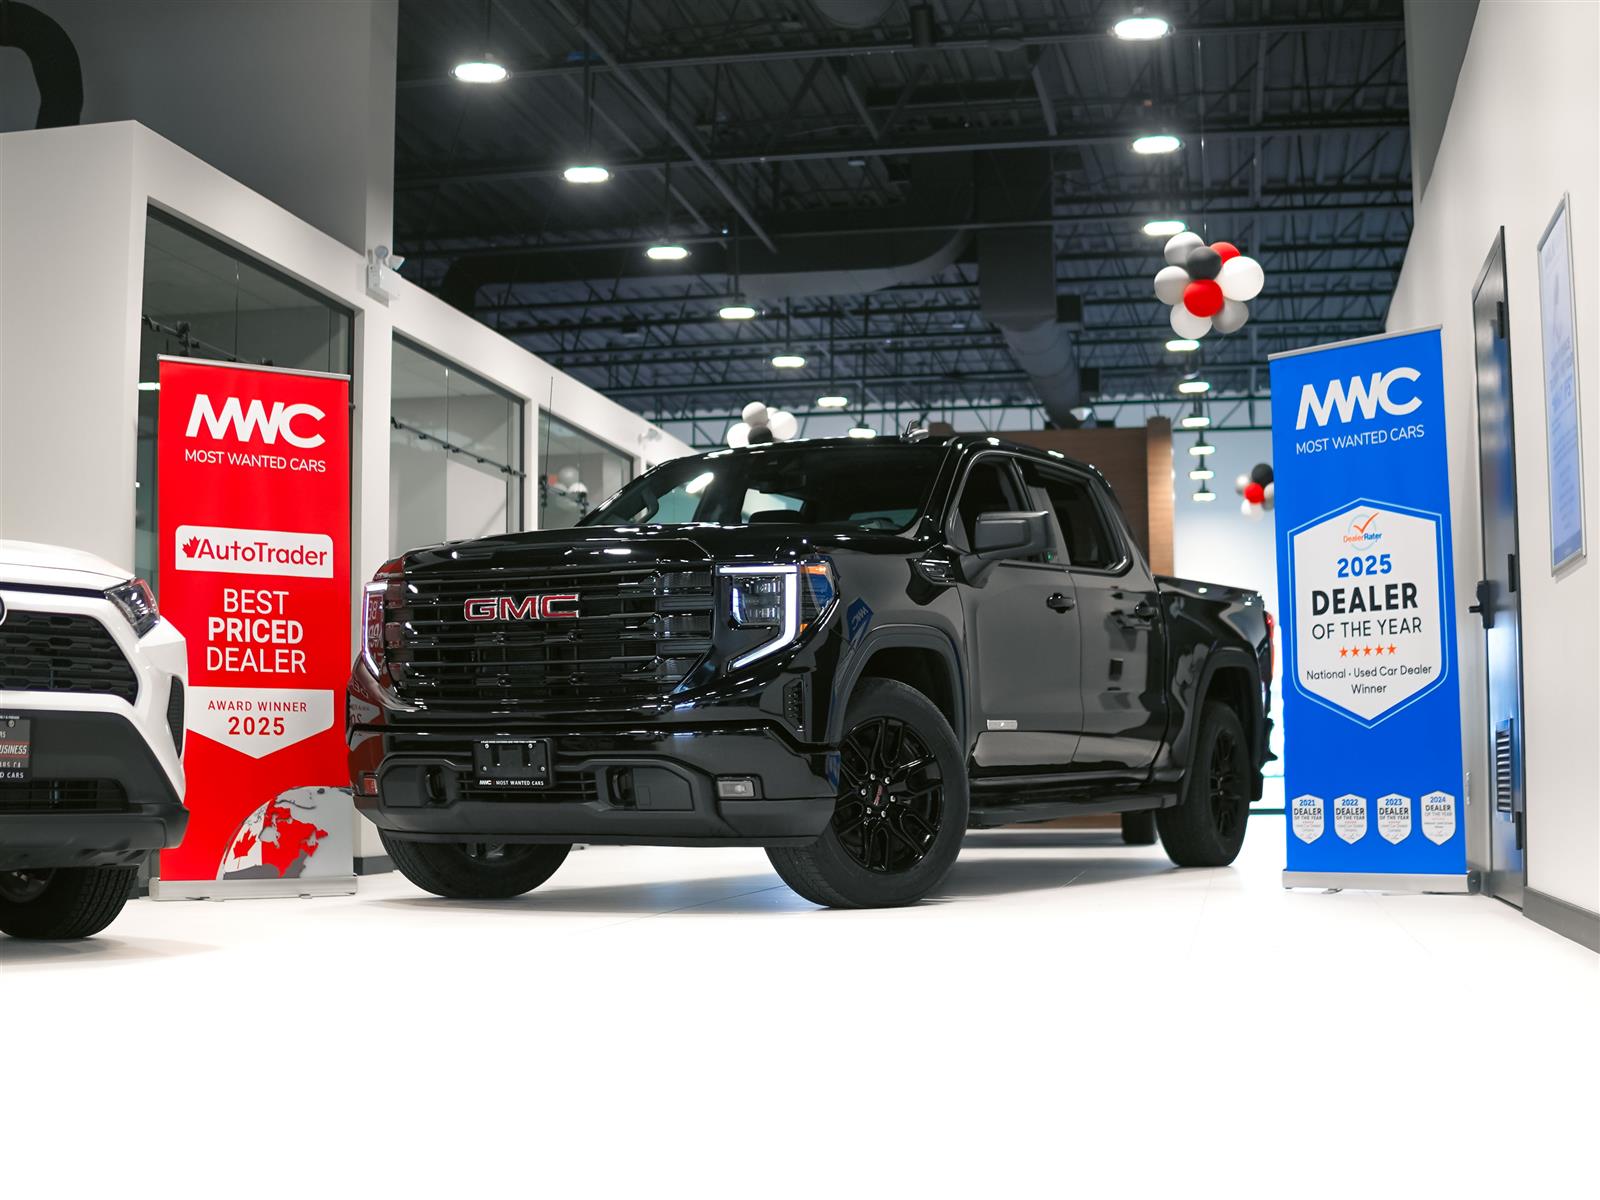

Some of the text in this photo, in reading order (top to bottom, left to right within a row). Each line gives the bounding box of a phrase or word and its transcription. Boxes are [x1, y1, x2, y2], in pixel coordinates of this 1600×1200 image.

[1296, 366, 1423, 430] MWC
[185, 393, 326, 449] MWC
[1296, 424, 1425, 454] MOST WANTED CARS
[185, 448, 326, 473] MOST WANTED CARS
[198, 538, 328, 566] AutoTrader
[1337, 553, 1392, 578] 2025
[223, 588, 290, 615] BEST
[463, 593, 580, 622] GMC
[1311, 582, 1419, 617] DEALER
[208, 616, 304, 644] PRICED
[1311, 616, 1423, 640] OF THE YEAR
[206, 646, 307, 674] DEALER
[1306, 664, 1432, 680] National Used Car Dealer
[1351, 684, 1388, 695] Winner
[207, 700, 308, 713] AWARD WINNER
[228, 716, 285, 736] 2025
[1294, 808, 1322, 816] DEALER
[1299, 799, 1316, 807] 2021
[1336, 808, 1365, 816] DEALER
[1341, 799, 1359, 807] 2022
[1379, 807, 1409, 815] DEALER
[1385, 798, 1403, 806] 2023
[1430, 796, 1446, 804] 2024
